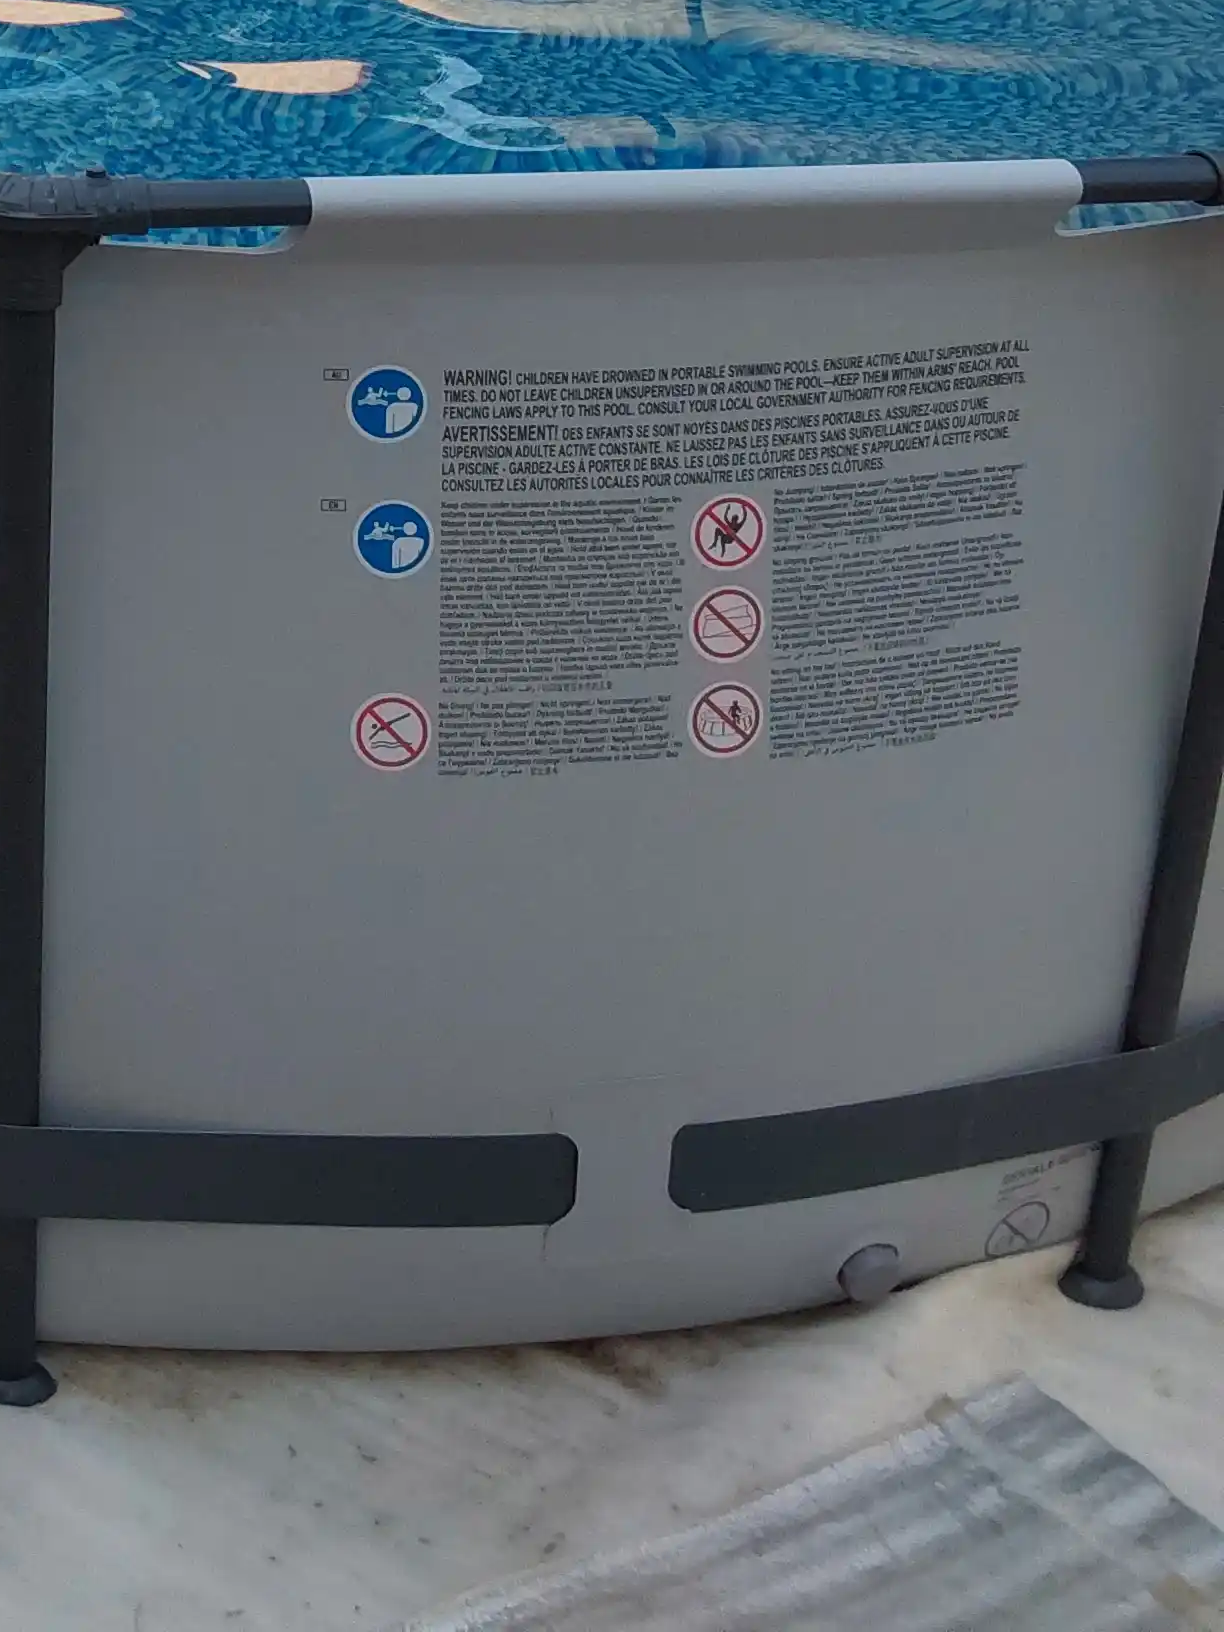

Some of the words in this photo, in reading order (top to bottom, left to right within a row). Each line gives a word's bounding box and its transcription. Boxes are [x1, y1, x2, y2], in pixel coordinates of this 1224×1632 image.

[444, 369, 512, 386] WARNING!
[516, 372, 568, 385] CHILDREN
[572, 370, 599, 384] HAVE
[602, 368, 656, 384] DROWNED
[658, 368, 668, 380] IN
[671, 366, 726, 380] PORTABLE
[728, 362, 781, 378] SWIMMING
[784, 360, 820, 374] POOLS.
[824, 356, 864, 371] ENSURE
[866, 353, 900, 368] ACTIVE
[903, 349, 934, 364] ADULT
[936, 344, 998, 360] SUPERVISION
[1000, 340, 1012, 352] AT
[1013, 340, 1030, 352] ALL
[480, 390, 496, 402] DO
[500, 389, 521, 402] NOT
[524, 388, 557, 402] LEAVE
[560, 388, 613, 401] CHILDREN
[616, 384, 694, 399] UNSUPERVISED
[698, 384, 708, 396] IN
[710, 382, 725, 395] OR
[728, 380, 770, 393] AROUND
[774, 378, 793, 391] THE
[862, 370, 888, 384] THEM
[892, 366, 925, 381] WITHIN
[996, 356, 1020, 370] POOL
[443, 406, 490, 419] FENCING
[492, 406, 522, 419] LAWS
[524, 406, 558, 418] APPLY
[561, 404, 575, 417] TO
[578, 404, 600, 416] THIS
[638, 400, 686, 414] CONSULT
[688, 399, 716, 413] YOUR
[720, 396, 754, 411] LOCAL
[756, 392, 826, 409] GOVERNMENT
[828, 386, 885, 403] AUTHORITY
[887, 384, 906, 397] FOR
[908, 380, 950, 395] FENCING
[442, 425, 558, 442] AVERTISSEMENT!
[562, 427, 582, 440] DES
[586, 426, 634, 440] ENFANTS
[636, 426, 649, 438] SE
[652, 423, 681, 437] SONT
[720, 419, 749, 433] DANS
[752, 418, 772, 432] DES
[774, 414, 820, 430] PISCINES
[442, 445, 512, 458] SUPERVISION
[514, 444, 556, 458] ADULTE
[558, 444, 596, 457] ACTIVE
[666, 440, 680, 452] NE
[683, 437, 726, 452] LAISSEZ
[728, 436, 748, 450] PAS
[750, 434, 769, 448] LES
[772, 431, 817, 447] ENFANTS
[820, 428, 846, 442] SANS
[848, 420, 922, 440] SURVEILLANCE
[924, 416, 950, 431] DANS
[952, 414, 966, 428] OU
[968, 411, 1006, 426] AUTOUR
[1008, 409, 1020, 422] DE
[442, 462, 456, 475] LA
[458, 462, 500, 475] PISCINE
[588, 459, 630, 473] PORTER
[634, 458, 648, 472] DE
[684, 456, 704, 468] LES
[706, 454, 730, 468] LOIS
[732, 453, 746, 466] DE
[798, 447, 818, 460] DES
[820, 444, 860, 458] PISCINE
[942, 430, 971, 445] CETTE
[442, 479, 504, 492] CONSULTEZ
[507, 478, 526, 491] LES
[591, 475, 640, 489] LOCALES
[642, 473, 672, 488] POUR
[736, 468, 754, 482] LES
[808, 462, 828, 476] DES
